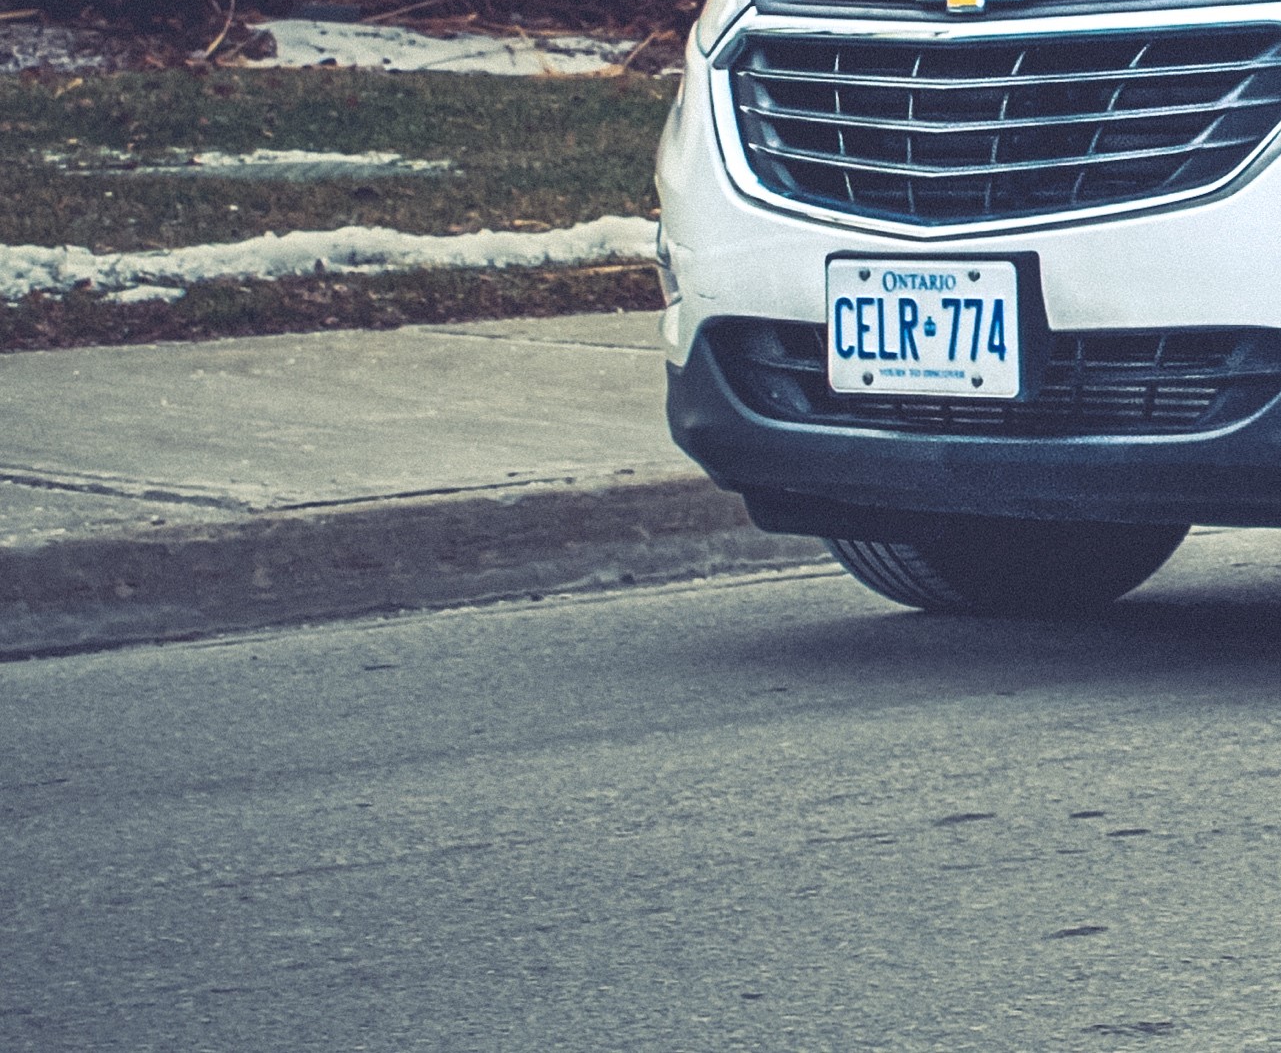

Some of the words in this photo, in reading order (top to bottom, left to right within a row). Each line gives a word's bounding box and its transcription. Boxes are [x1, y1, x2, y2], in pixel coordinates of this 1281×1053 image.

[882, 270, 957, 293] ONTARIO
[834, 297, 919, 361] CELR
[941, 298, 1007, 362] 774
